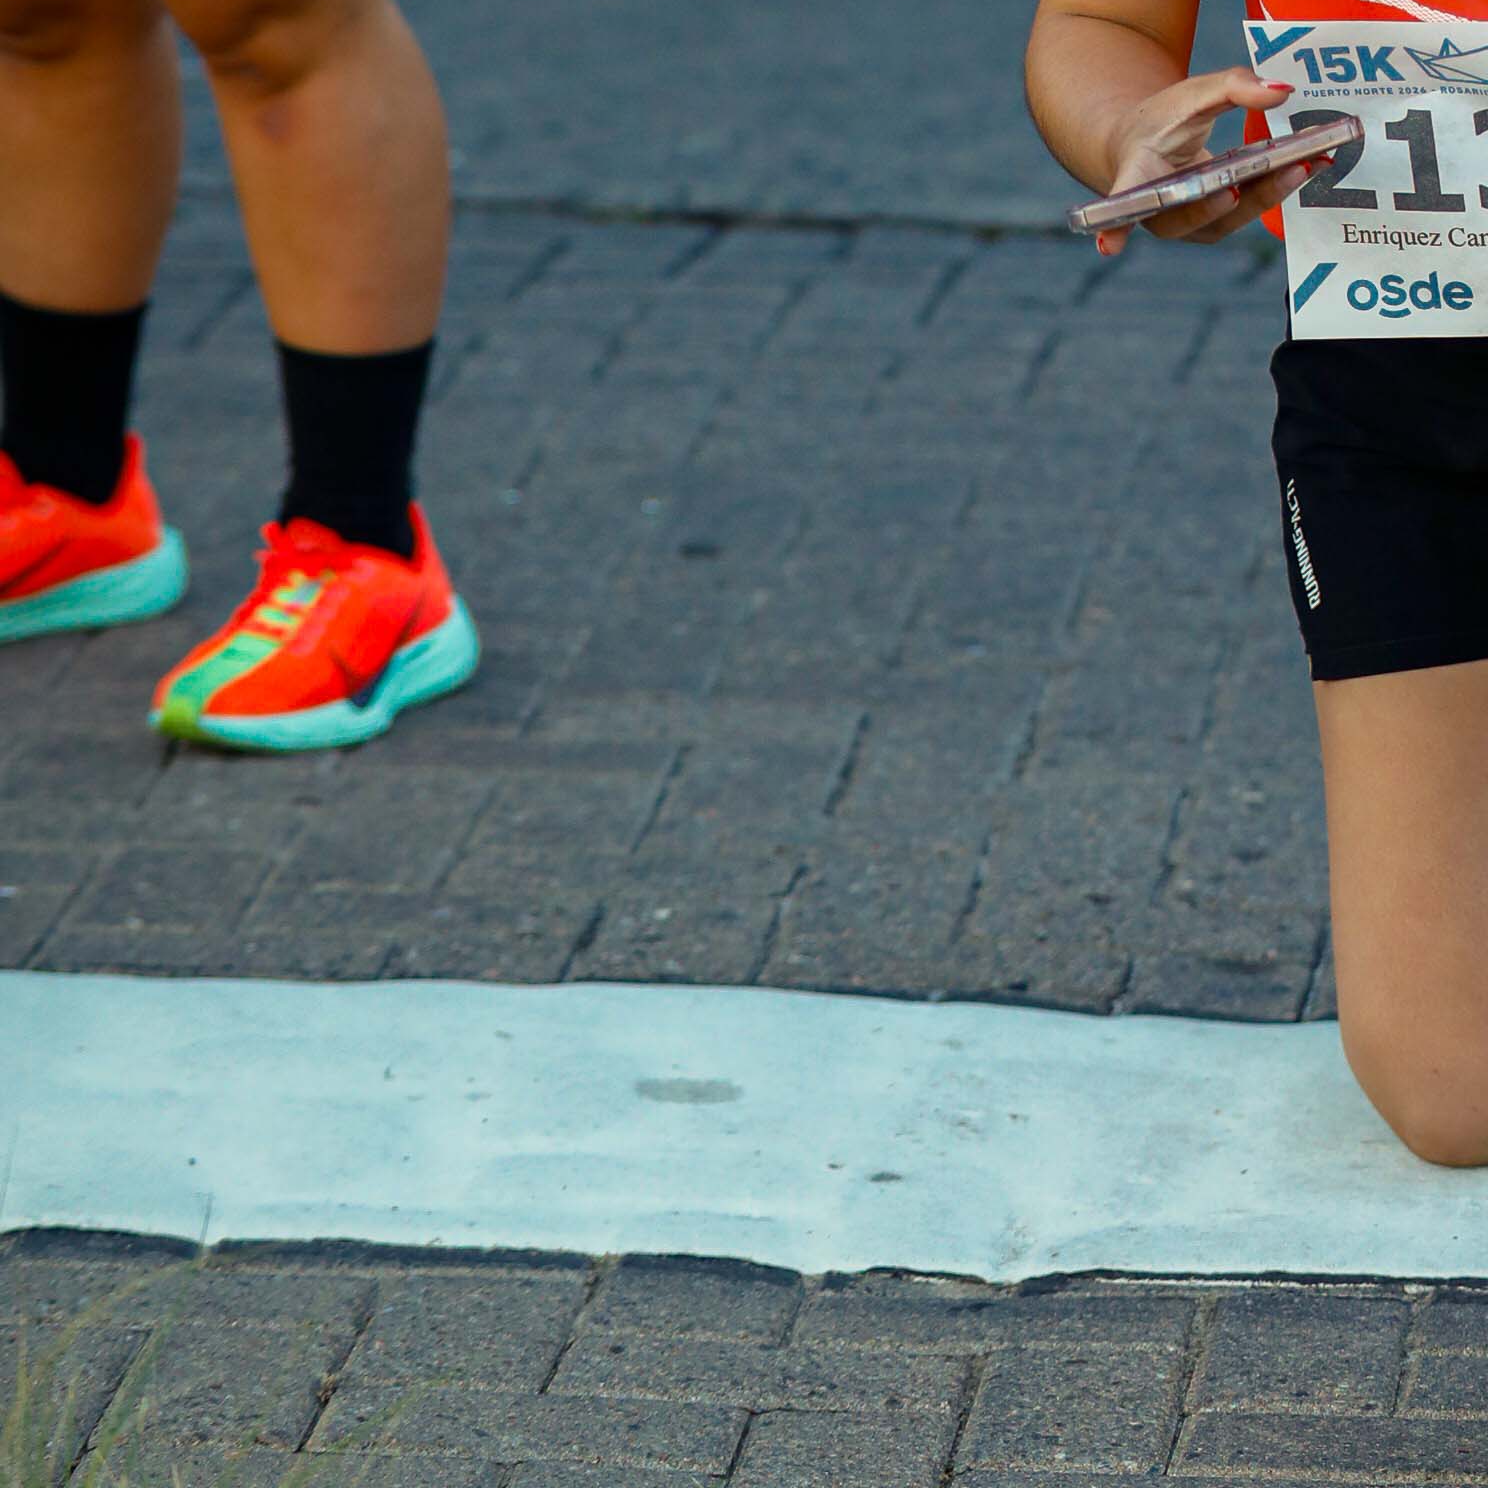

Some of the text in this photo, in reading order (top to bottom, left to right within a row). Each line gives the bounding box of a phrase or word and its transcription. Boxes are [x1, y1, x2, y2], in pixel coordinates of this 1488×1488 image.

[1293, 45, 1407, 84] 15K
[1303, 87, 1351, 99] PUERTO
[1354, 86, 1394, 97] NORTE
[1398, 86, 1427, 96] 2026
[1341, 223, 1443, 251] Enriquez
